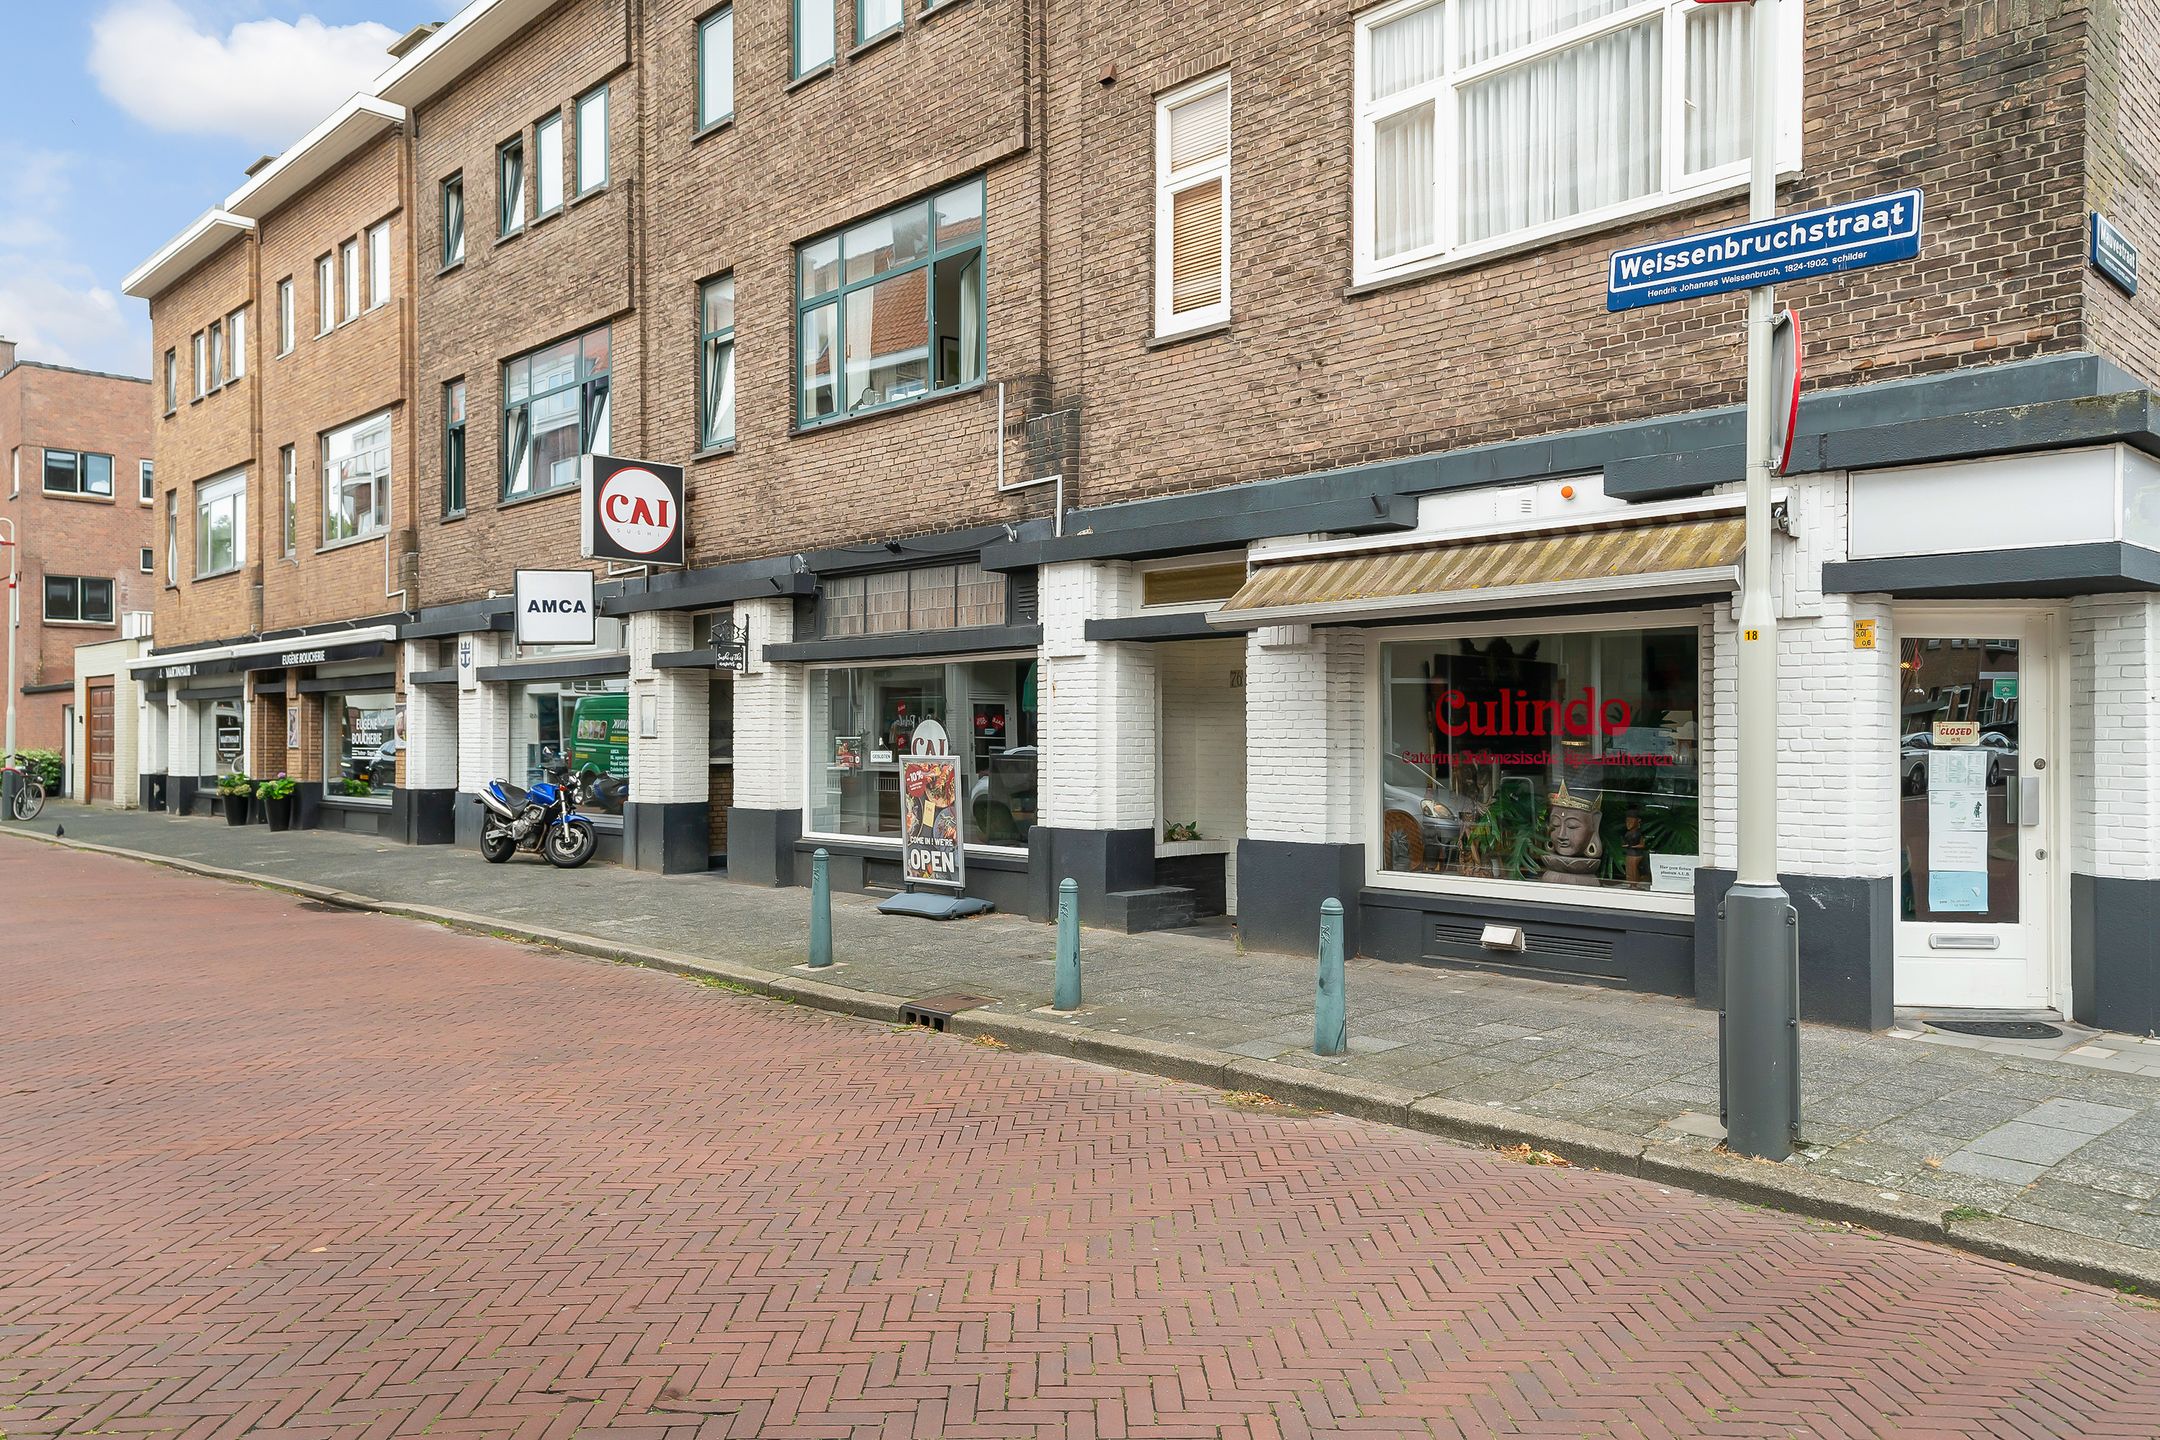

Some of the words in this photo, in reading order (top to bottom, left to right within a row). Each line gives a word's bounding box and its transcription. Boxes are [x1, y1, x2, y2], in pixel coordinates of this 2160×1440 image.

[1620, 202, 1905, 280] Weissenbruchstraat
[1647, 285, 1678, 298] Hendrik
[1679, 279, 1719, 292] Johannes
[1721, 267, 1781, 284] Weissenbruch,
[1784, 257, 1829, 273] 1824-1902,
[1832, 250, 1868, 264] schilder
[606, 494, 669, 528] CAI
[616, 528, 661, 537] SUSHI
[527, 599, 587, 613] AMCA
[1745, 630, 1758, 641] 18
[299, 650, 325, 663] BOUCHERIE
[1435, 686, 1632, 737] Culindo
[351, 732, 383, 745] BOUCHERIE
[1940, 727, 1972, 736] CLOSED
[912, 737, 947, 755] CAI
[1401, 750, 1460, 767] Catering
[910, 836, 924, 845] COME
[910, 848, 955, 873] OPEN
